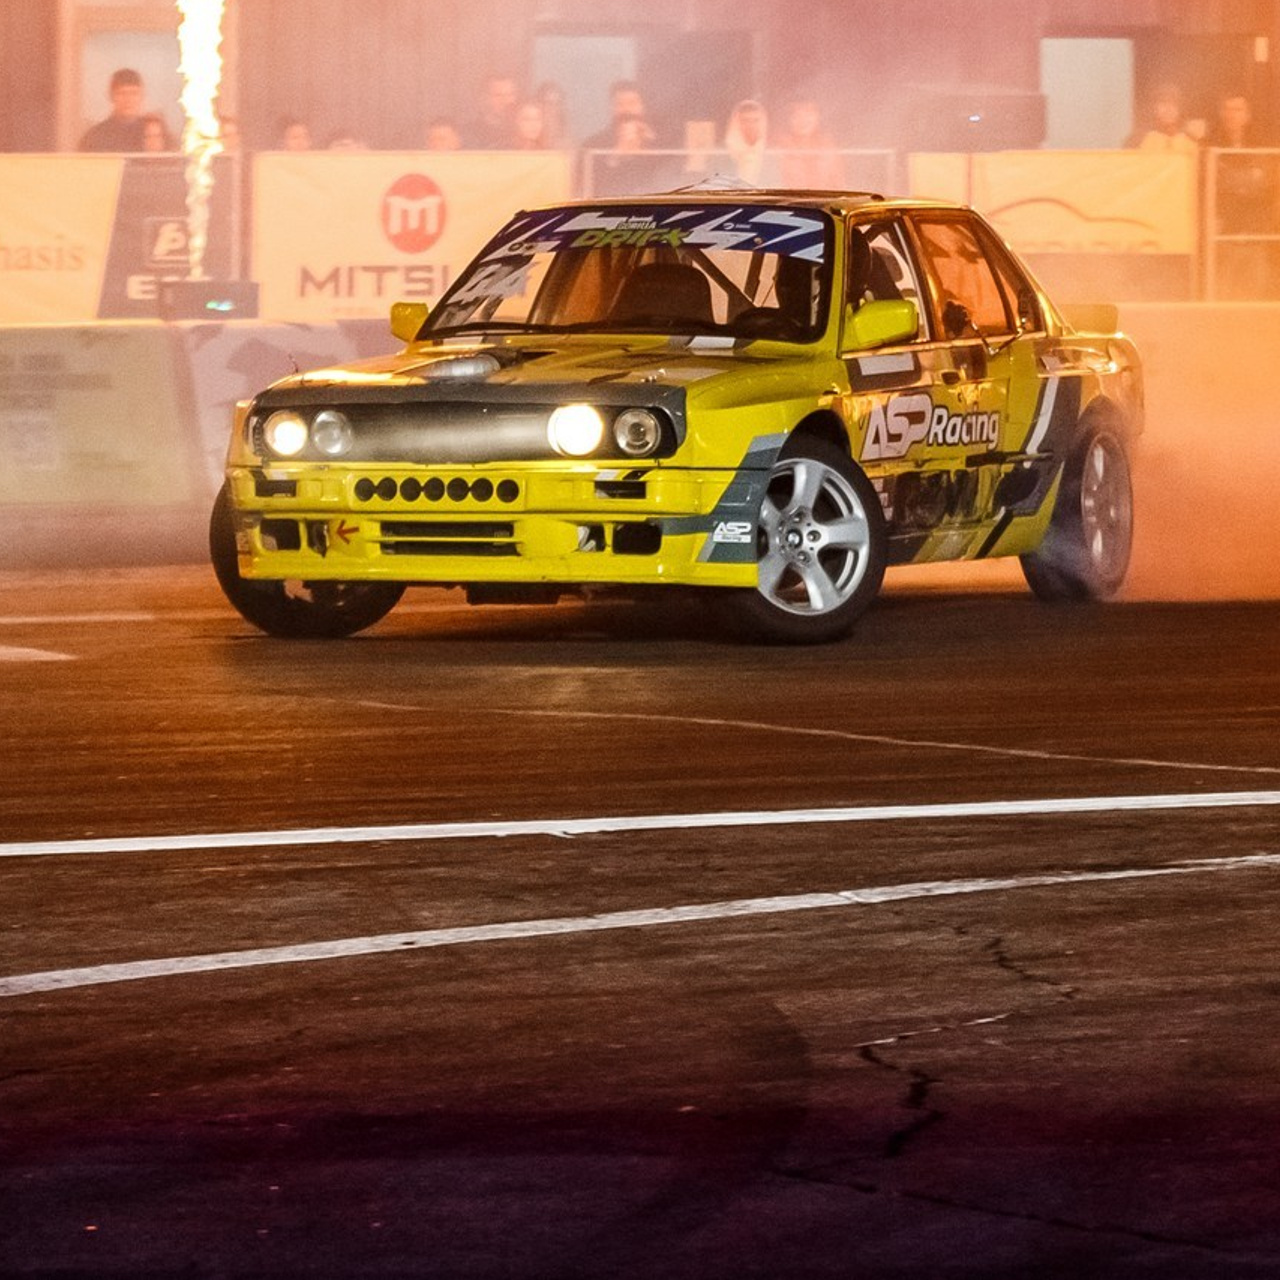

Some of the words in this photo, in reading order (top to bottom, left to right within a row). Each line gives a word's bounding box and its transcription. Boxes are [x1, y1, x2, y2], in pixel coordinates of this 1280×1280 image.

[0, 234, 85, 270] asis
[299, 265, 450, 298] MITSI
[860, 393, 931, 462] ASP
[927, 405, 999, 449] Racing
